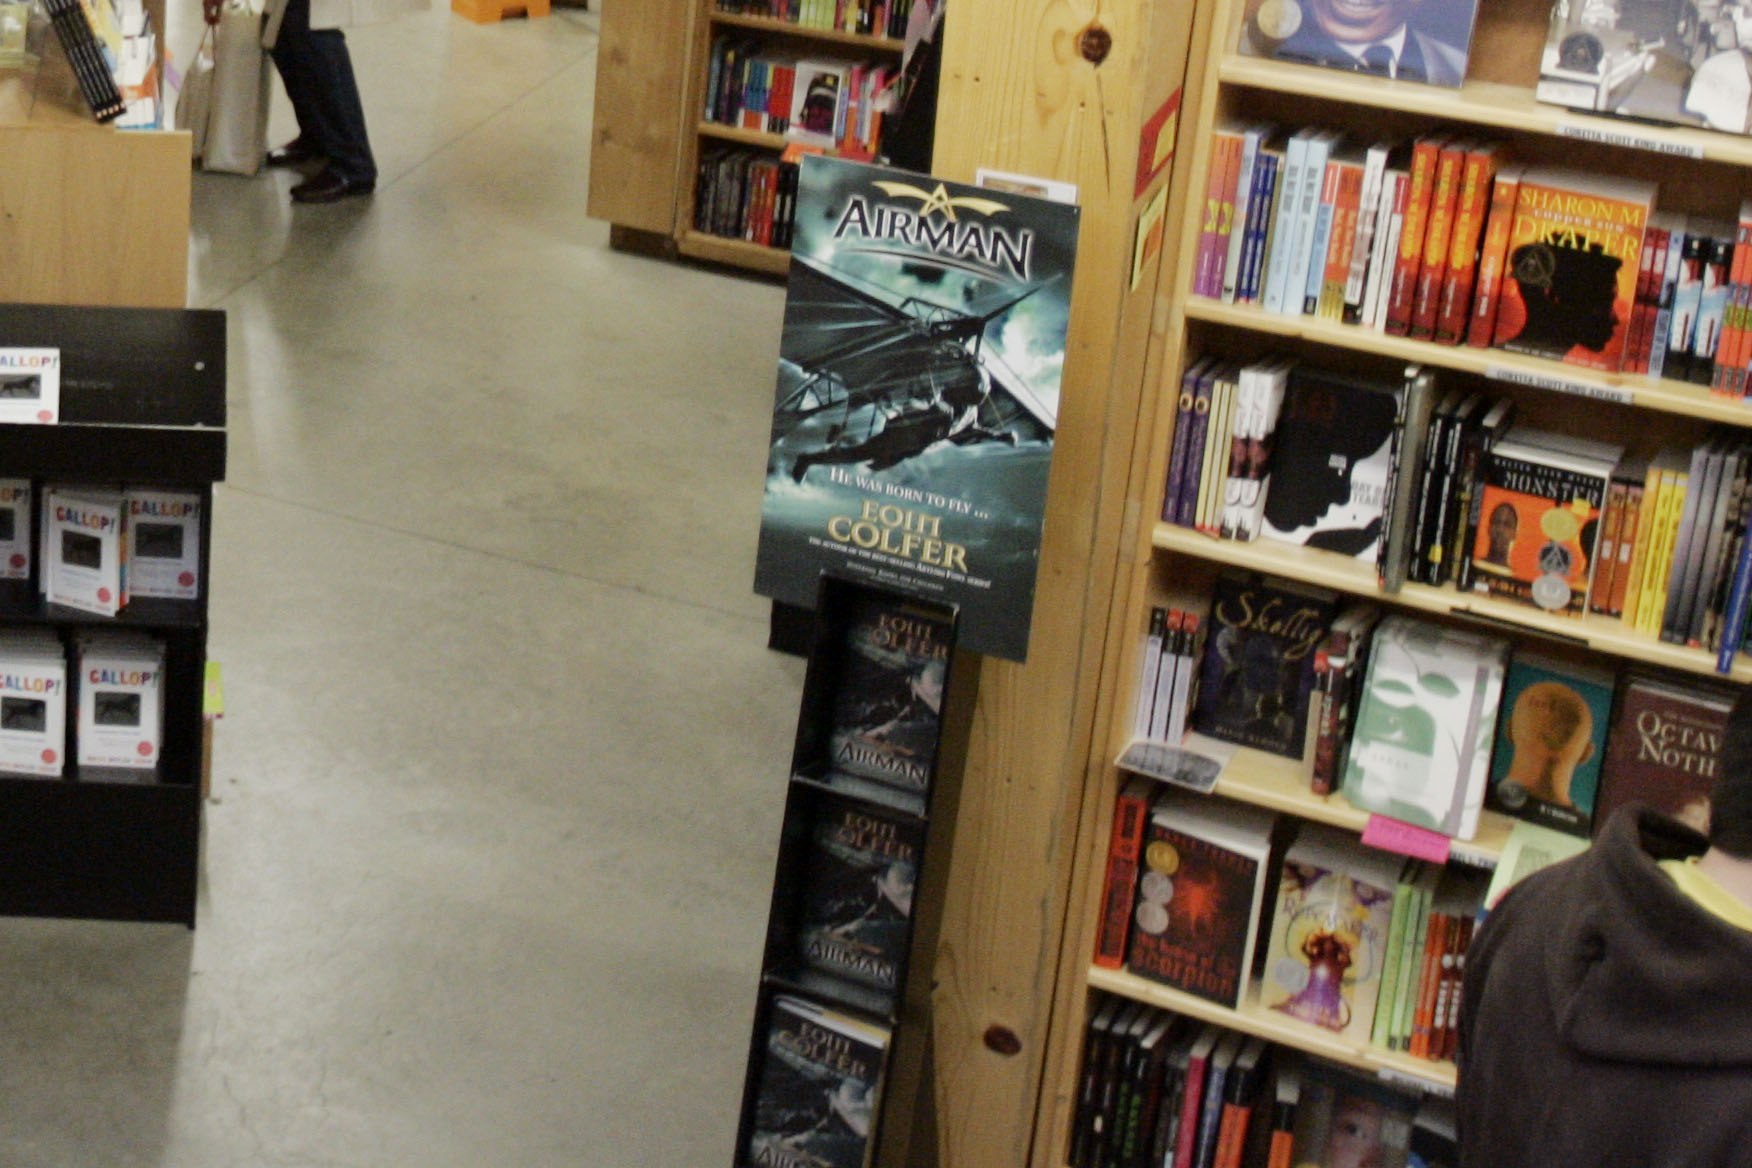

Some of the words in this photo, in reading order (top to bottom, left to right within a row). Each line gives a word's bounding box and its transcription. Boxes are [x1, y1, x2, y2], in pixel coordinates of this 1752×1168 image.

[1520, 187, 1614, 221] SHARON
[832, 194, 1033, 282] AIRMAN
[1515, 215, 1640, 261] DRAPER
[130, 499, 199, 519] GALLOP!
[855, 475, 883, 494] WAS
[885, 482, 924, 504] BORN
[925, 492, 946, 510] TO
[948, 498, 973, 516] FLY
[1503, 471, 1600, 508] MONSTER
[56, 505, 116, 535] GALLOP!
[827, 515, 969, 575] COLFER
[89, 669, 161, 688] GALLOP!
[838, 741, 928, 785] AIRMAN
[809, 940, 897, 985] AIRMAN
